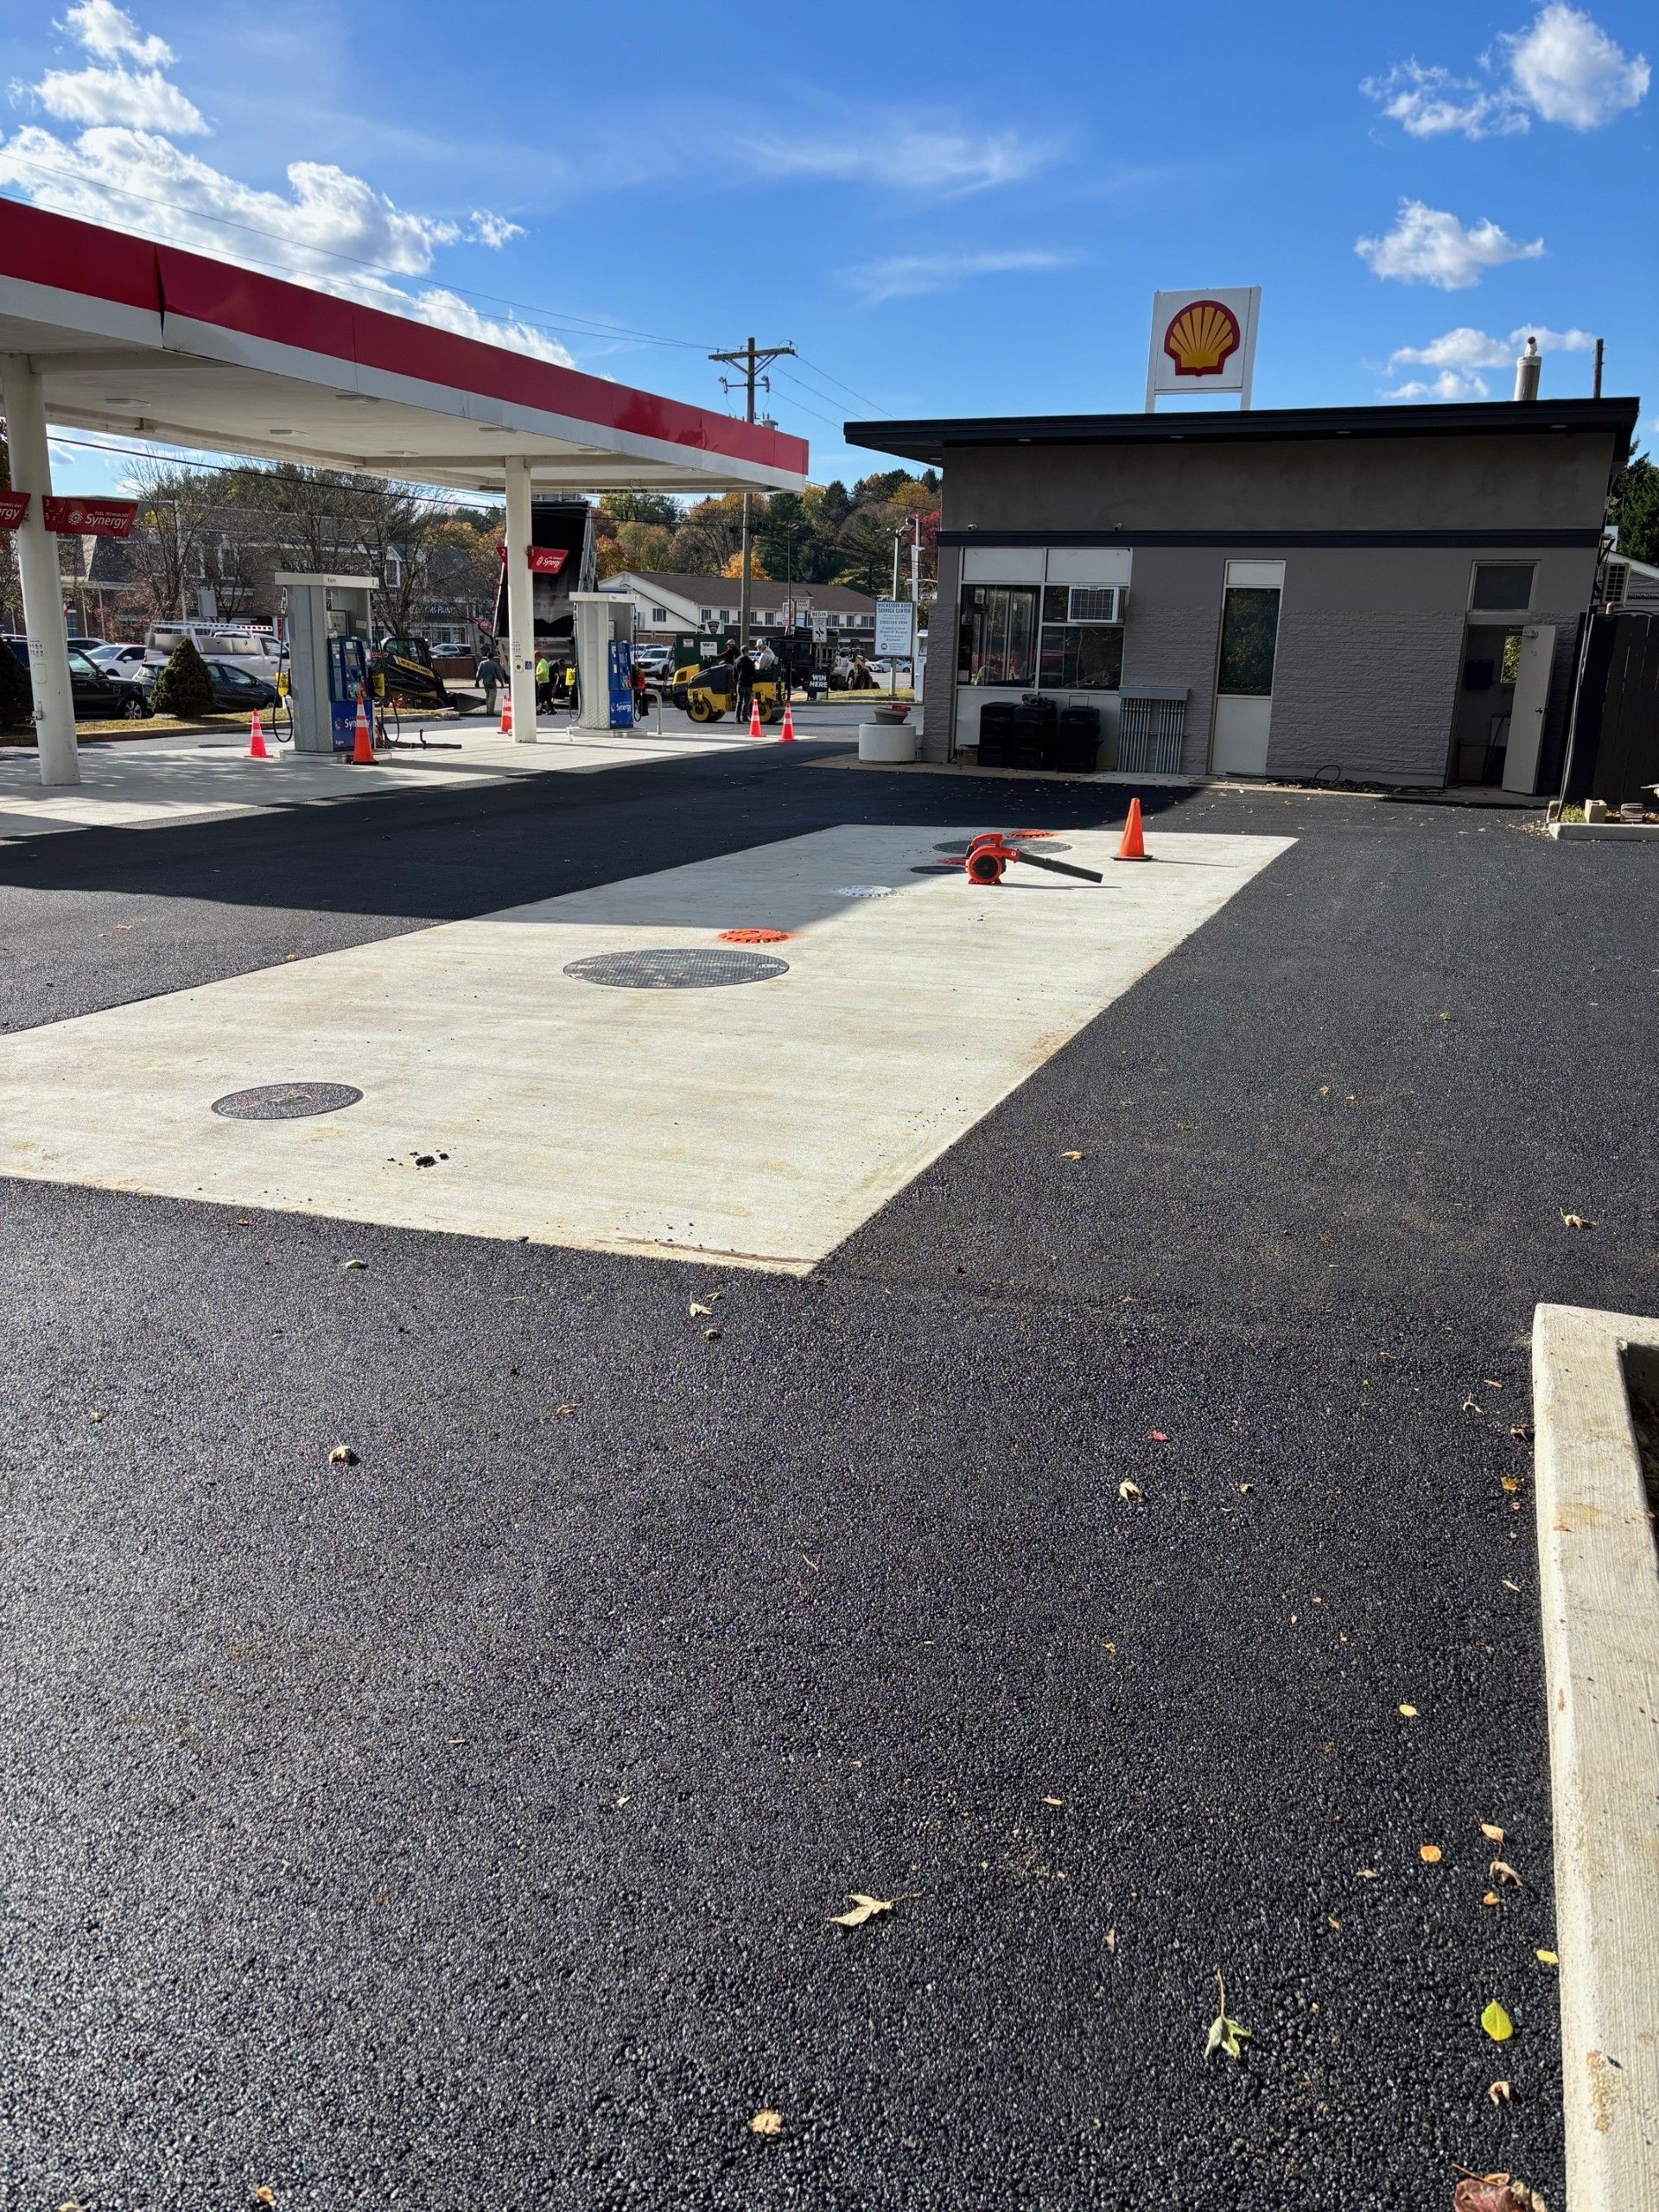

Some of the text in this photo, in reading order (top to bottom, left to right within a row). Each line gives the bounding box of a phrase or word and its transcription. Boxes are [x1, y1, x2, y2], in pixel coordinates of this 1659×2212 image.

[86, 512, 128, 529] Synergy
[543, 557, 562, 568] Synergy
[410, 663, 431, 675] HOLLAND
[616, 703, 632, 713] Synergy
